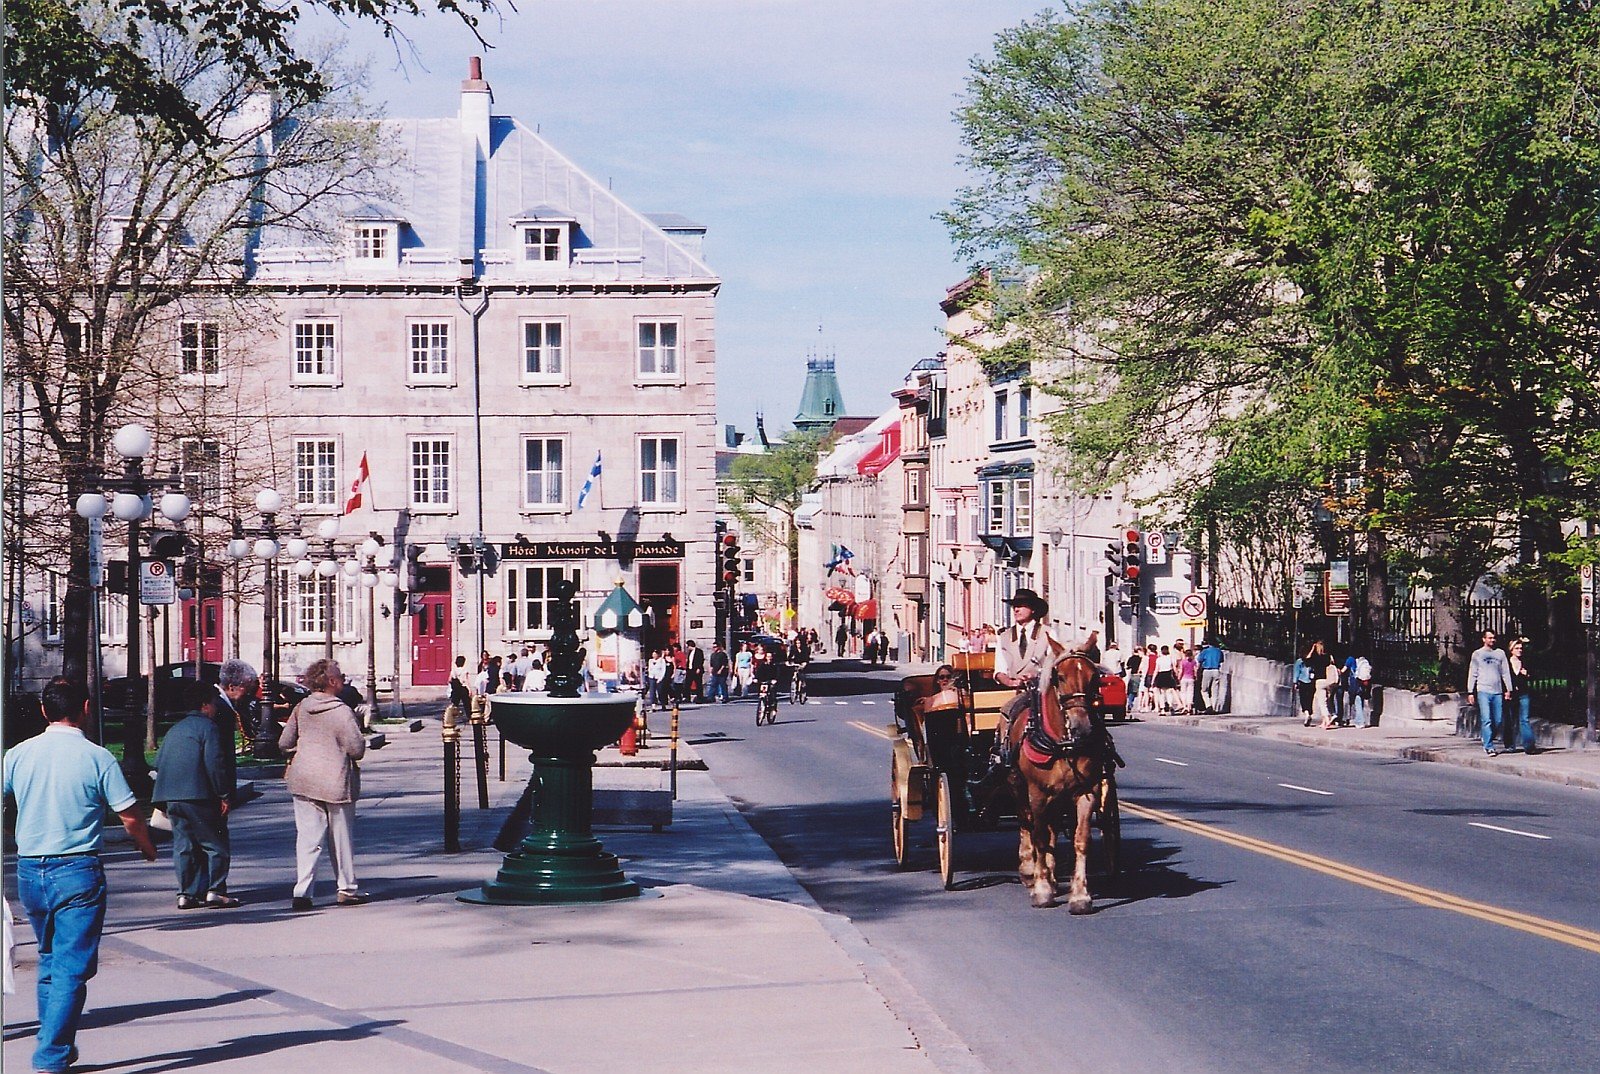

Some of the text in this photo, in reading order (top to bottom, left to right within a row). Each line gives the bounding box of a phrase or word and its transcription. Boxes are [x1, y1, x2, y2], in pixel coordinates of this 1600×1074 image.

[508, 545, 537, 556] Hôtel
[547, 545, 590, 555] Manoir
[594, 546, 607, 555] de
